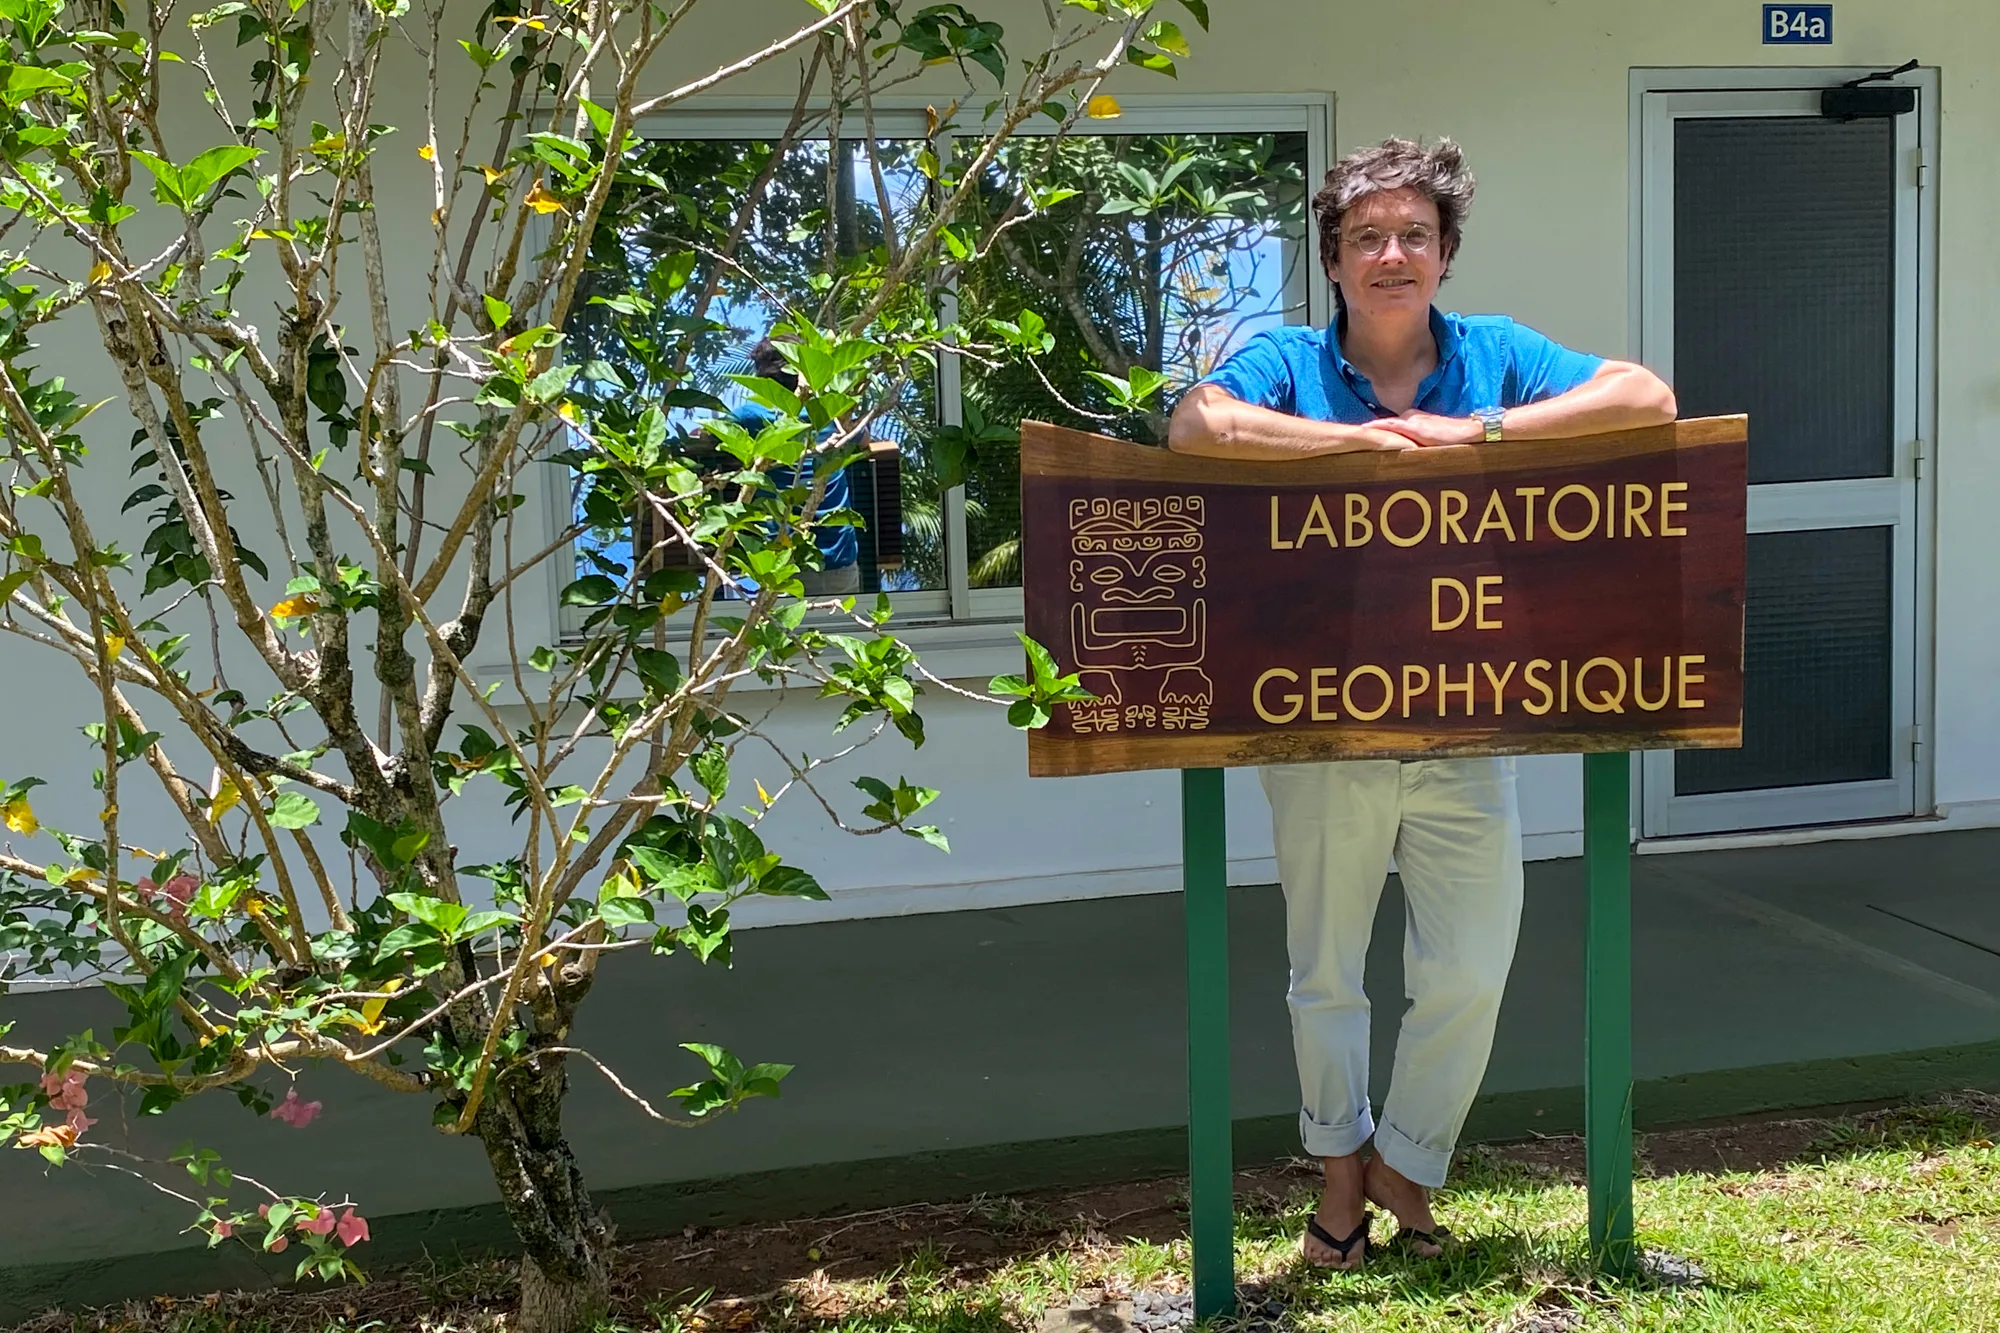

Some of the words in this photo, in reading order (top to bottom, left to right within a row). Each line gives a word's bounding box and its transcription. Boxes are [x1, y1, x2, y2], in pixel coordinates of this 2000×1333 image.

[1771, 10, 1825, 38] B4a
[1270, 482, 1689, 550] LABORATOIRE
[1431, 575, 1504, 632] DE
[1252, 654, 1706, 725] GEOPHYSIQUE
